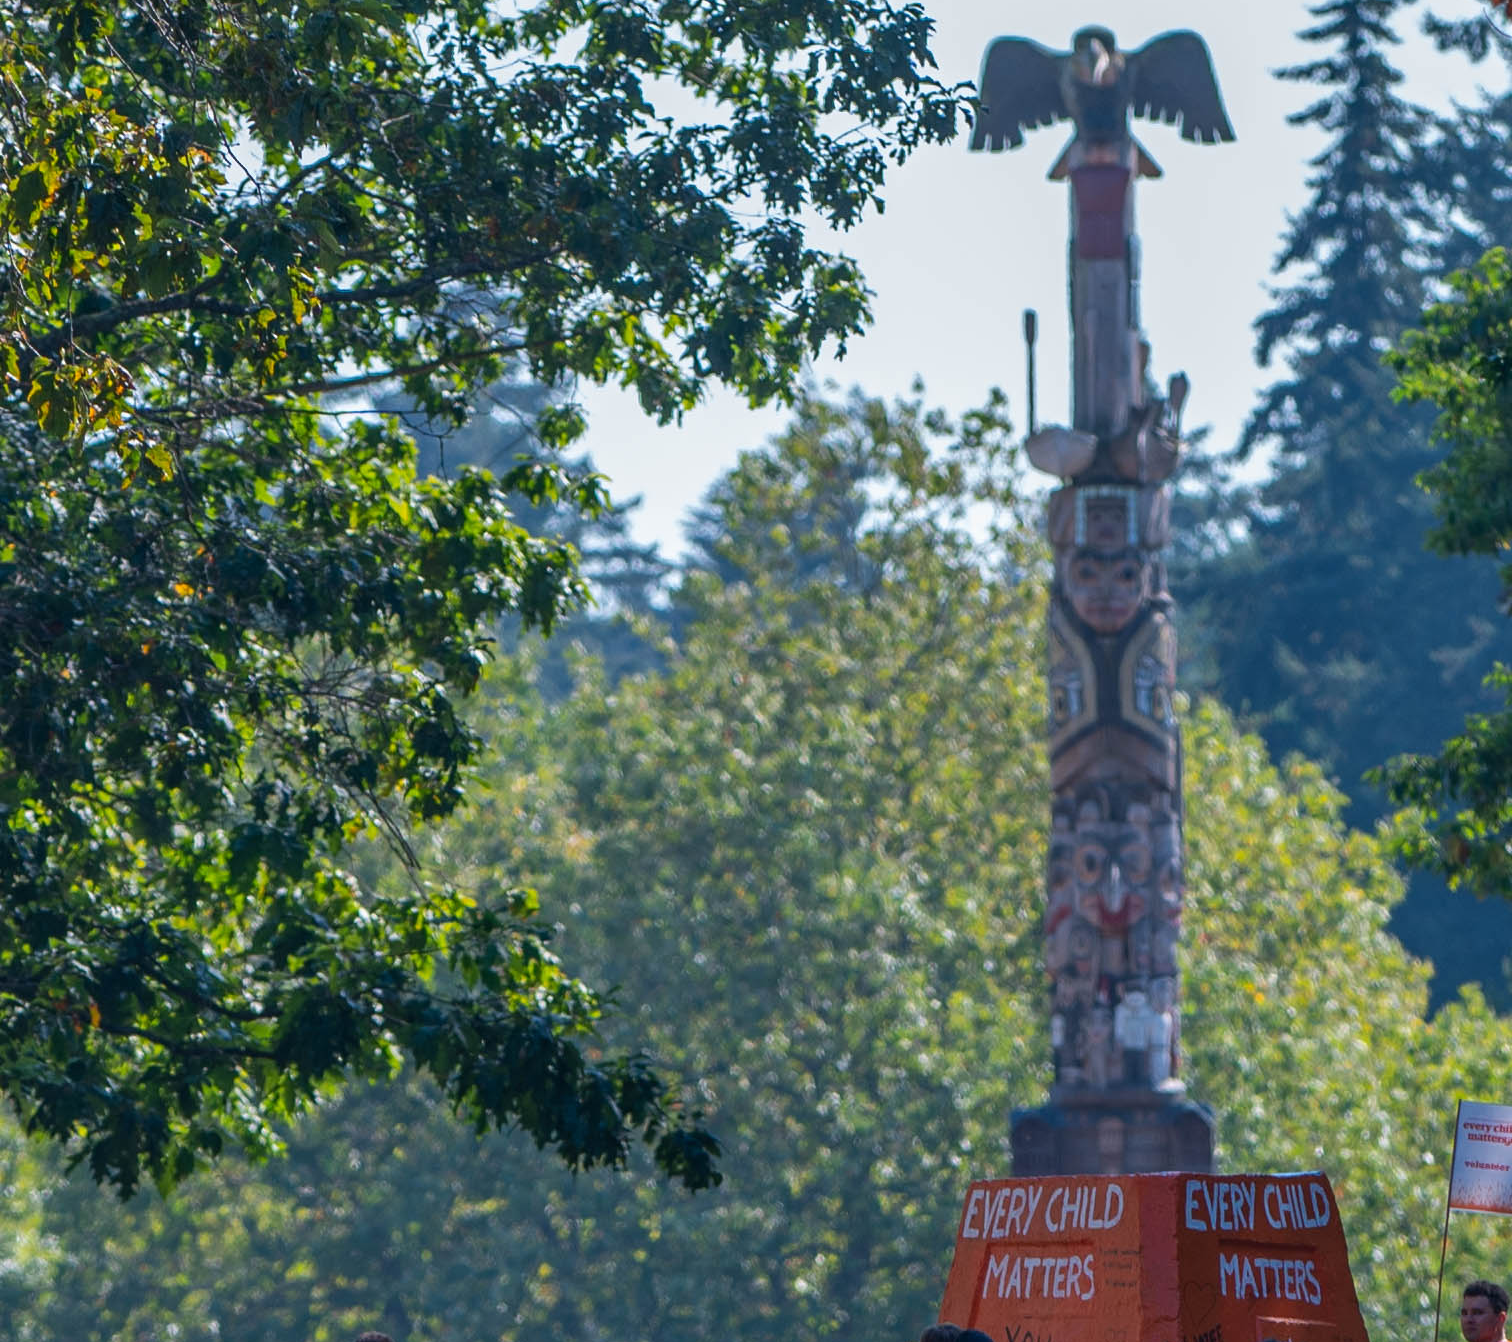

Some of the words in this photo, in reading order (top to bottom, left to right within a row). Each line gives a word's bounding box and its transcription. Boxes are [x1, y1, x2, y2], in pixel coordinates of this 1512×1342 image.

[1463, 1122, 1491, 1132] every
[1464, 1160, 1511, 1172] volunteer
[962, 1185, 1043, 1239] EVERY
[1045, 1183, 1124, 1232] CHILD
[1185, 1179, 1256, 1231] EVERY
[1263, 1183, 1331, 1230] CHILD
[982, 1254, 1095, 1300] MATTERS
[1219, 1253, 1322, 1305] MATTERS
